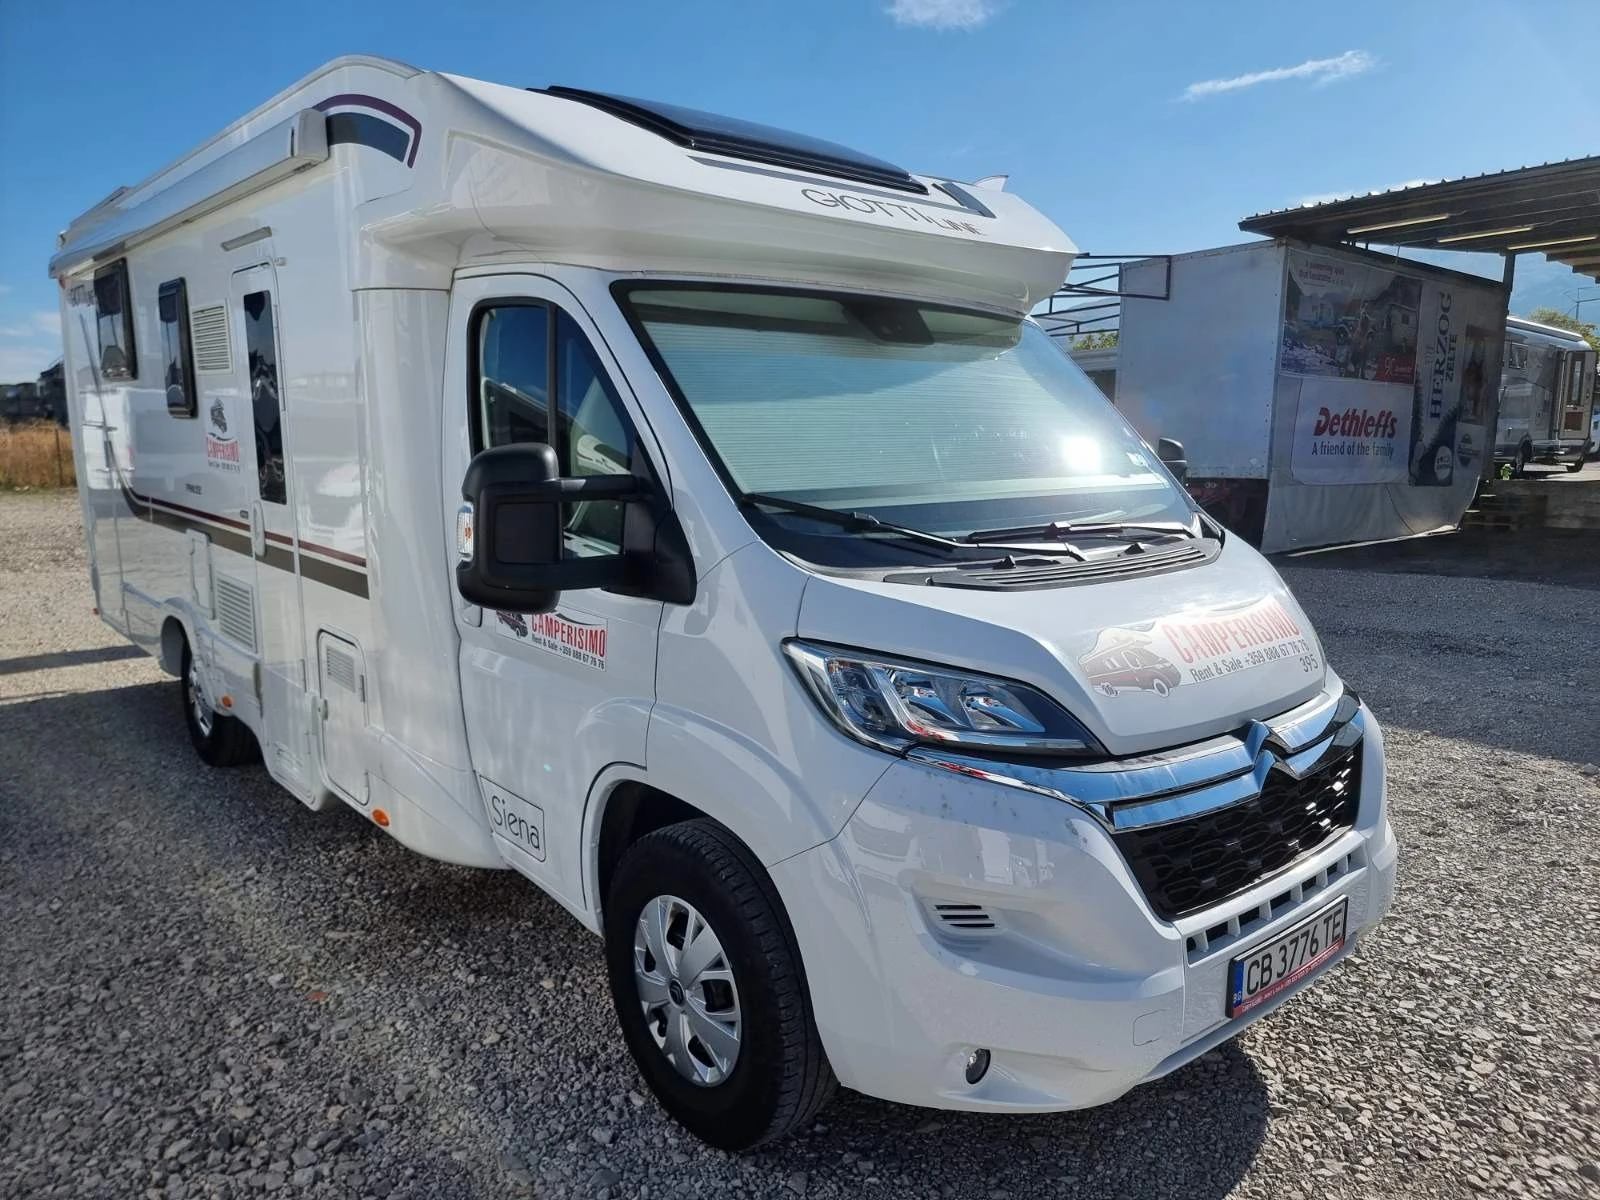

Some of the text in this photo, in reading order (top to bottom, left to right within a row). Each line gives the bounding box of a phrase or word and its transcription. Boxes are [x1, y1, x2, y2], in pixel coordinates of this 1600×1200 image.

[1430, 291, 1452, 418] HERZOG
[1446, 334, 1458, 382] ZELTE
[1313, 407, 1397, 438] Dethleffs
[1311, 441, 1394, 459] A friend of the family
[531, 612, 606, 657] CAMPERISIMO
[1162, 603, 1301, 663] CAMPERISIMO
[582, 652, 589, 663] 67
[1190, 666, 1214, 682] Rent
[1215, 663, 1223, 675] &
[1224, 658, 1244, 672] Sale
[1278, 643, 1290, 657] 67
[1300, 654, 1319, 672] 395
[492, 795, 540, 850] Siena
[1247, 953, 1272, 995] CB
[1276, 924, 1318, 978] 3776
[1324, 909, 1343, 948] TE
